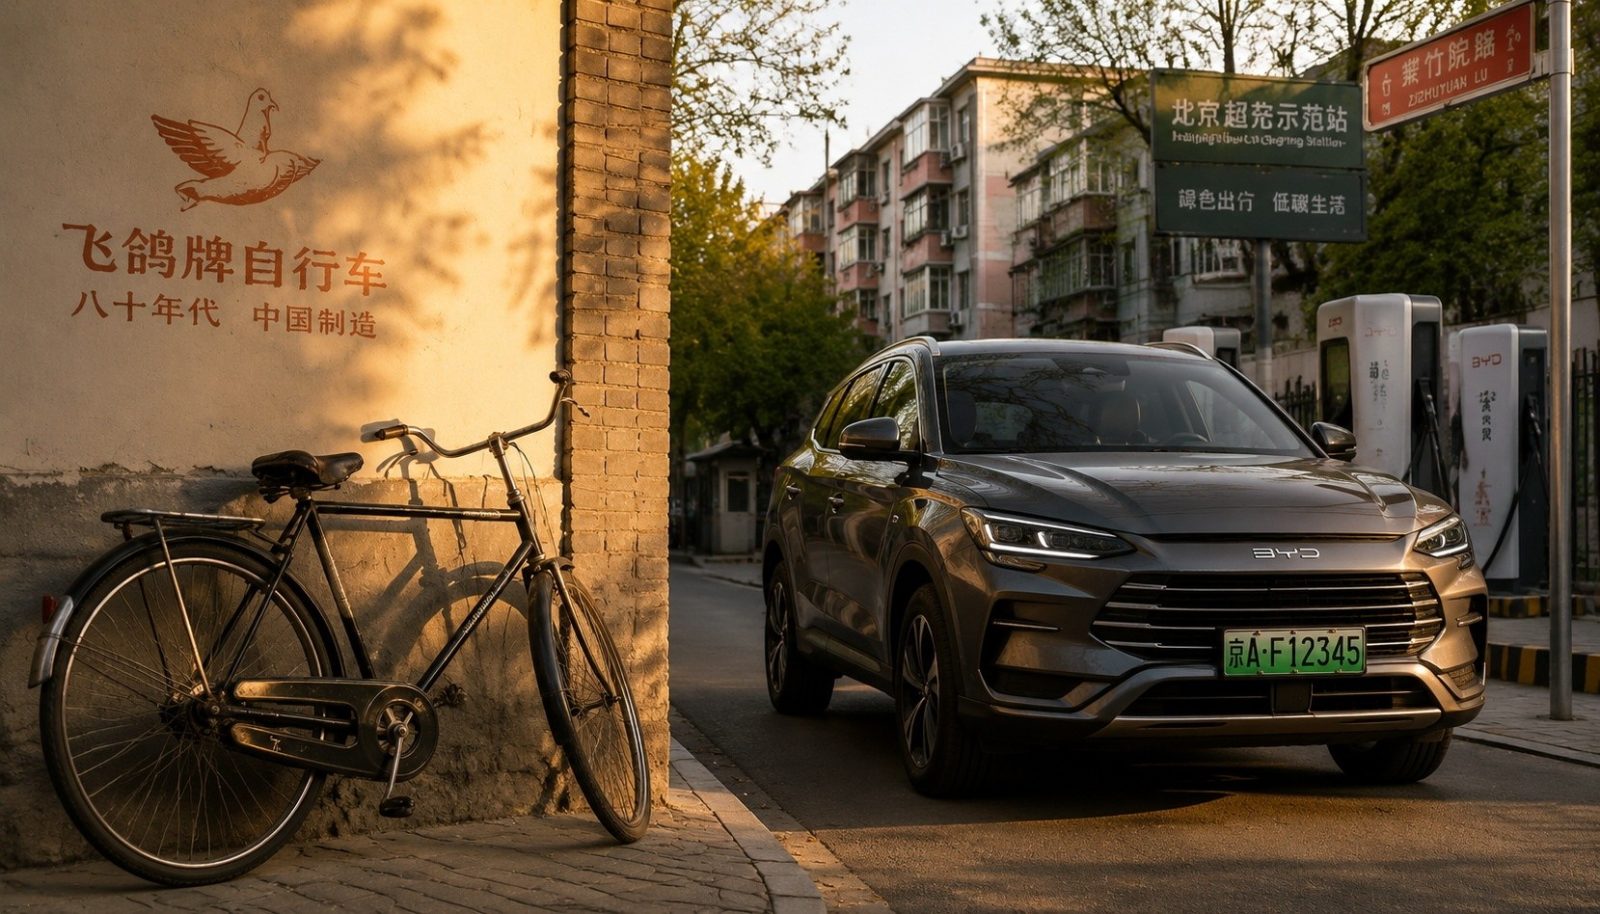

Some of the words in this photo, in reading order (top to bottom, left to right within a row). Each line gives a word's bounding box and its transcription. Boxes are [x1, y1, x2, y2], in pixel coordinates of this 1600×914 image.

[1474, 68, 1488, 83] LU
[62, 223, 387, 297] 飞鸽牌自行车
[71, 290, 221, 328] 八十年代
[253, 302, 377, 339] 中国制造
[1472, 353, 1502, 369] BYD
[1253, 547, 1320, 559] BYD
[1229, 636, 1360, 669] 京A·F12345
